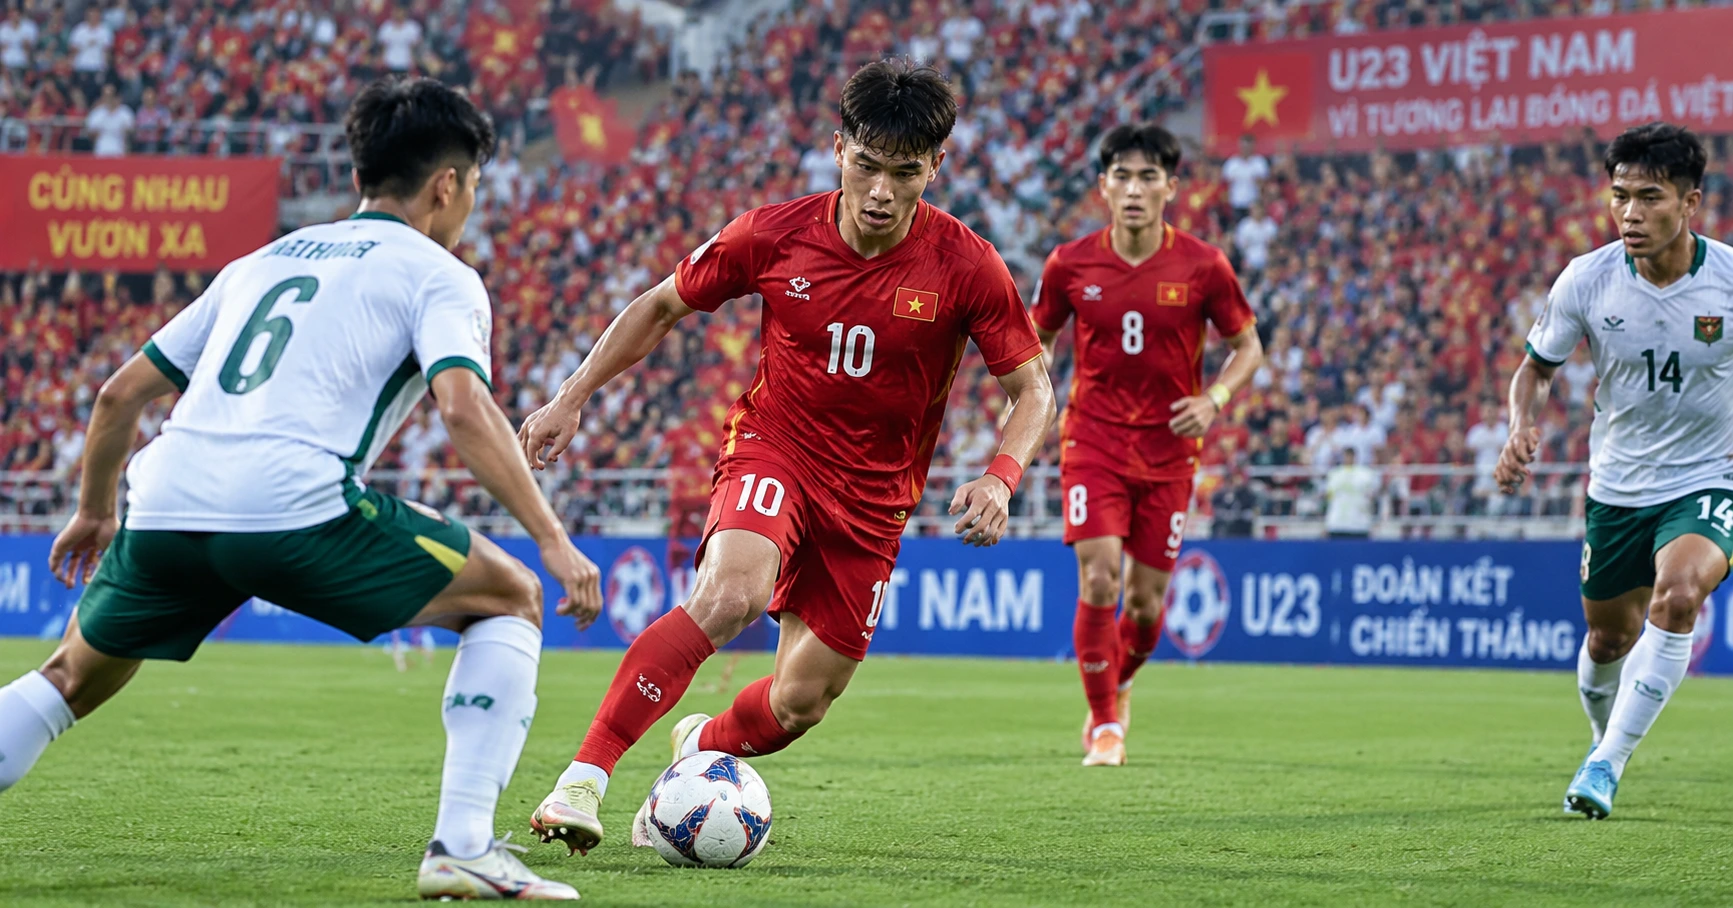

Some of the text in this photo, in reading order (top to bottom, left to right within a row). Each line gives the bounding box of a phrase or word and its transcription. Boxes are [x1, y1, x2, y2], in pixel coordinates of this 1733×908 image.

[1328, 28, 1635, 91] U23 VIỆT NAM
[1470, 95, 1519, 131] LAI
[1525, 82, 1611, 129] BÓNG
[132, 174, 229, 212] NHAU
[47, 216, 208, 259] VƯƠN XA
[218, 275, 320, 395] 6
[827, 322, 875, 378] 10
[1122, 310, 1144, 355] 8
[1641, 348, 1683, 393] 14
[735, 473, 785, 516] 10
[1068, 484, 1087, 526] 8
[1696, 494, 1733, 531] 14
[918, 567, 1044, 632] NAM
[1241, 572, 1322, 638] U23
[1449, 555, 1514, 606] KẾT
[1350, 605, 1450, 657] CHIẾN
